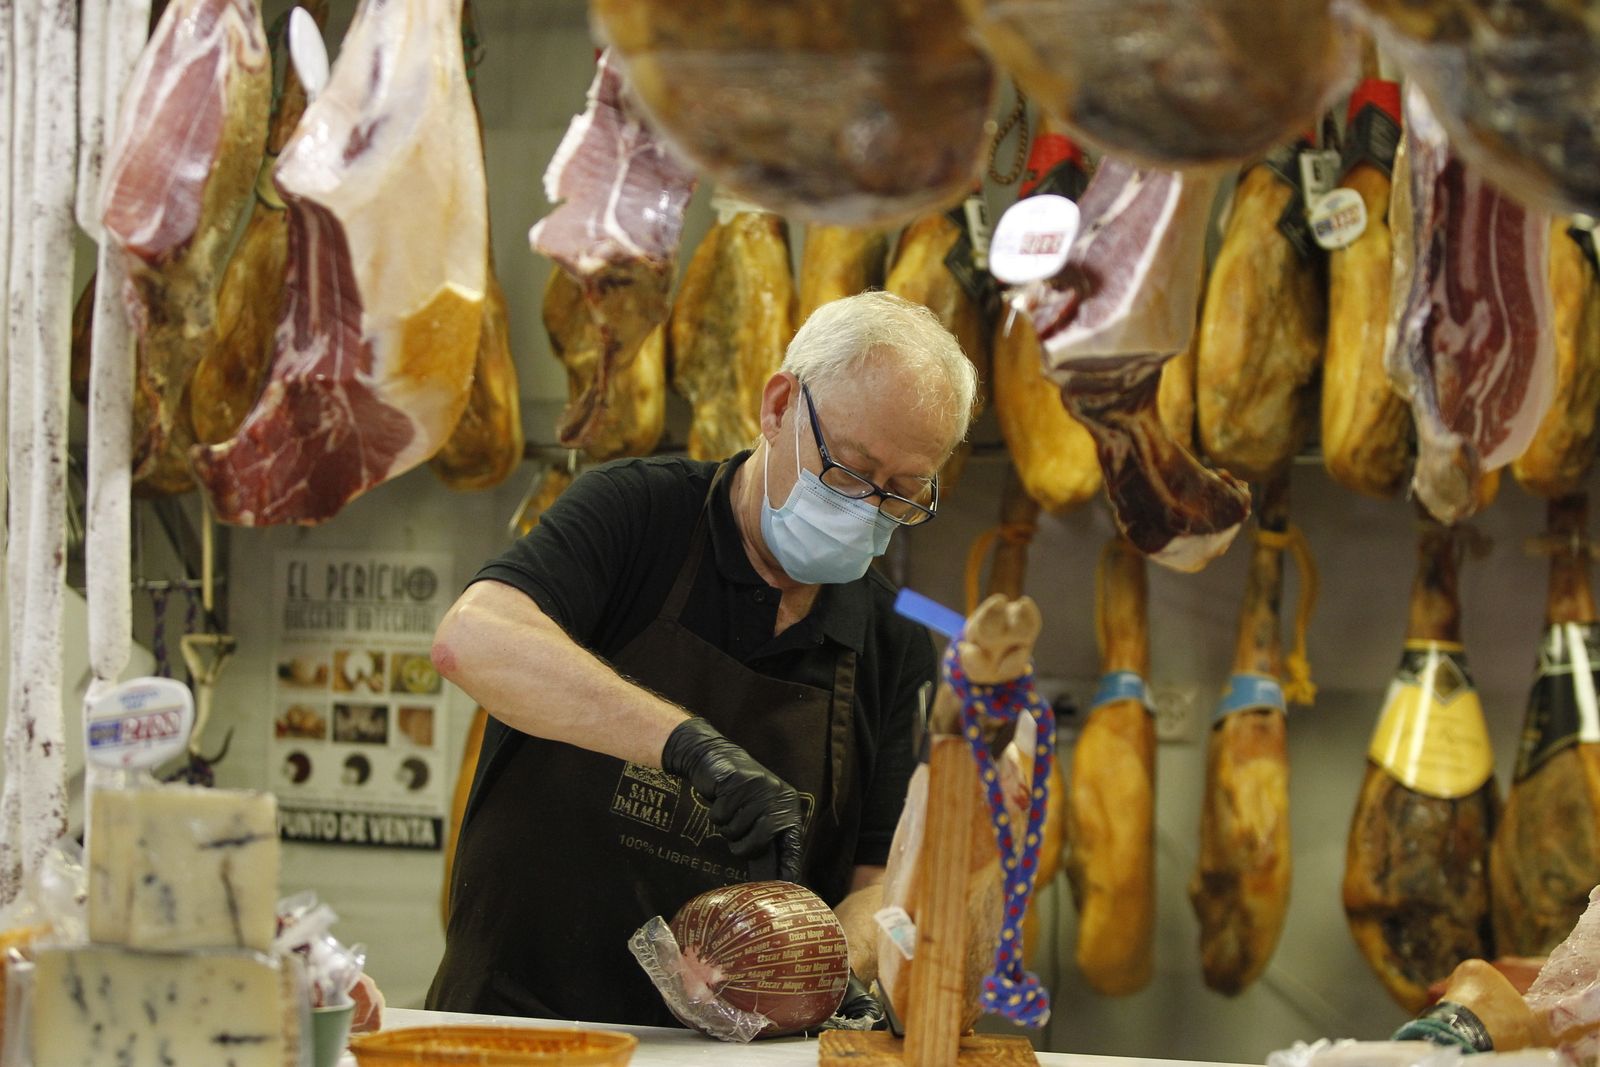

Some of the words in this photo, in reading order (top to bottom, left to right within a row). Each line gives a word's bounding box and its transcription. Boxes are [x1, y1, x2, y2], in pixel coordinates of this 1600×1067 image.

[288, 561, 309, 600] EL
[629, 783, 666, 808] SANT
[277, 810, 338, 839] PUNTO
[340, 812, 368, 843] DE
[368, 814, 435, 847] VENTA
[619, 834, 655, 855] 100%
[657, 846, 701, 870] LIBRE
[702, 861, 722, 876] DE
[789, 932, 806, 941] Oscar
[757, 953, 781, 963] Oscar
